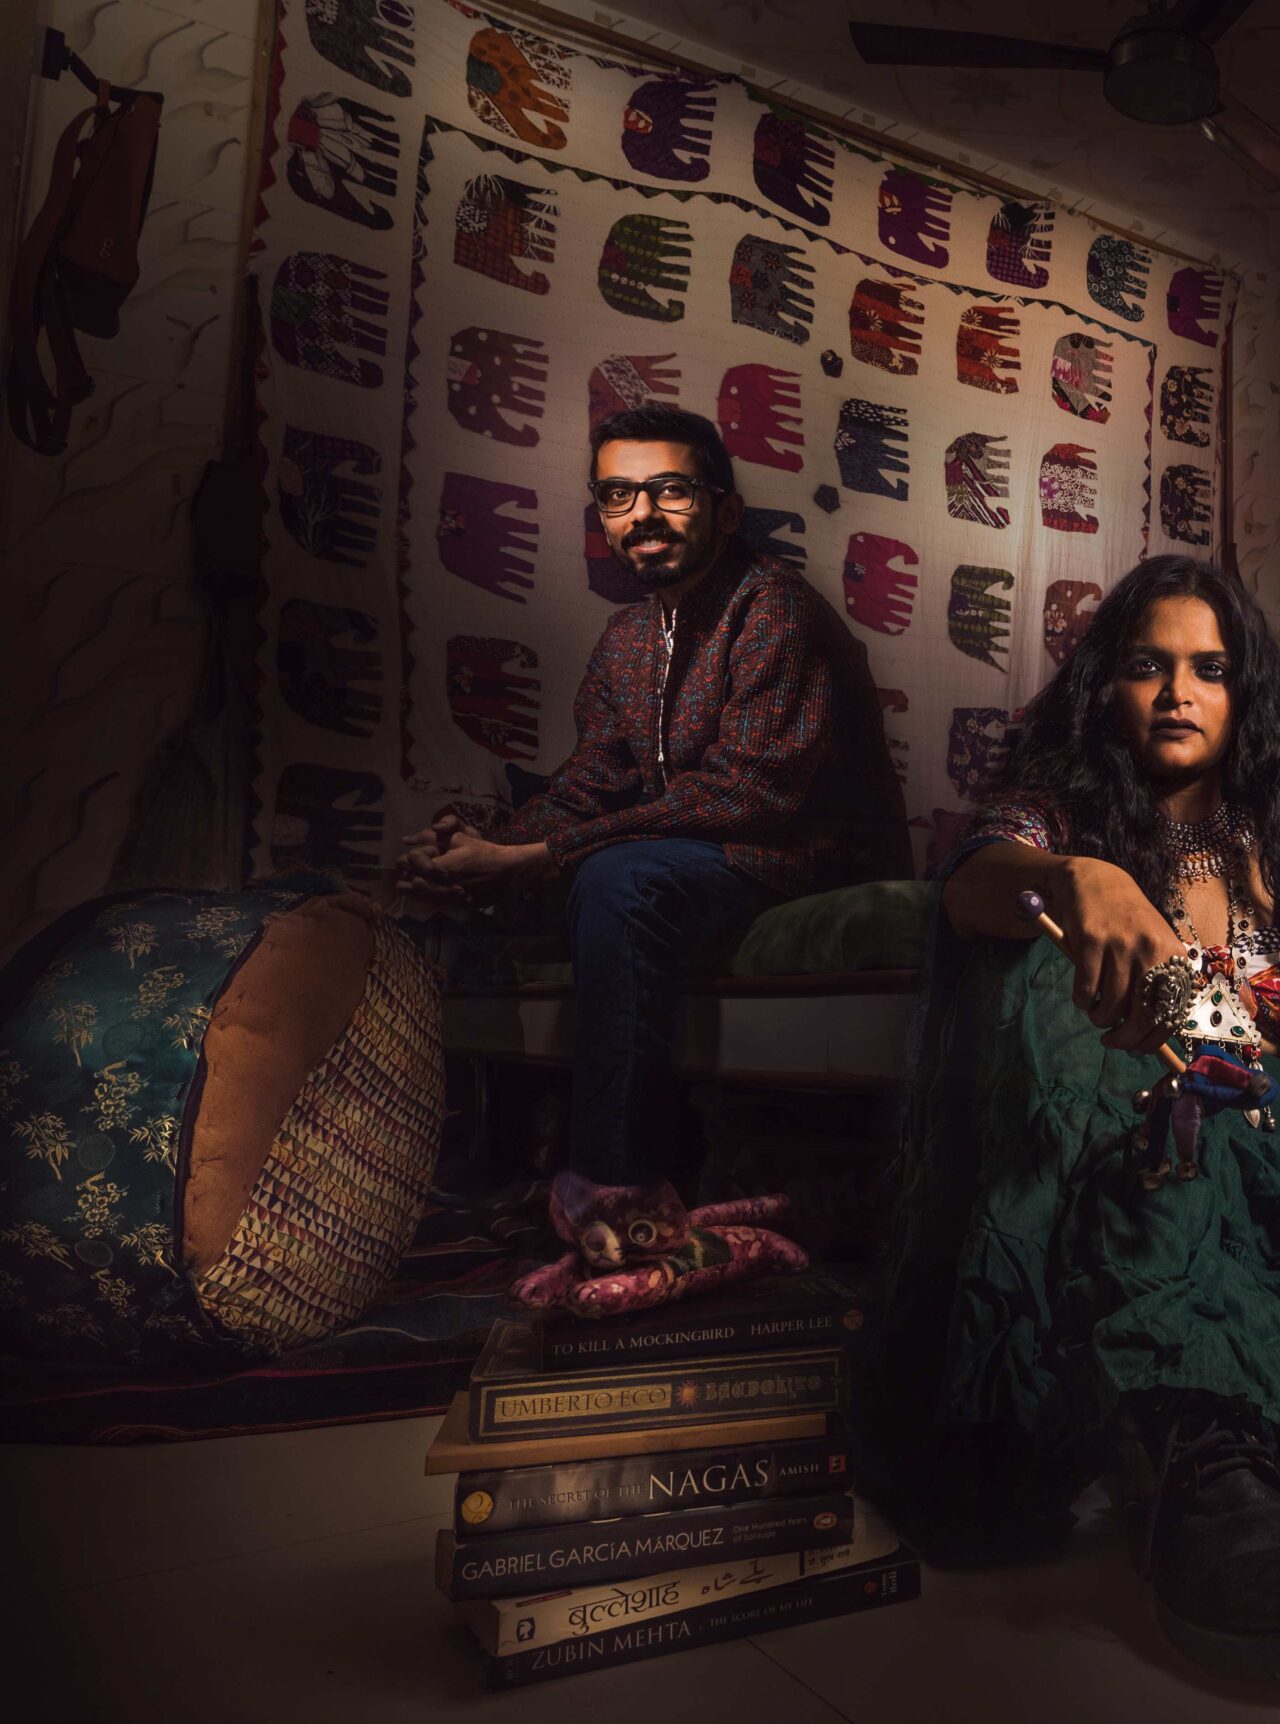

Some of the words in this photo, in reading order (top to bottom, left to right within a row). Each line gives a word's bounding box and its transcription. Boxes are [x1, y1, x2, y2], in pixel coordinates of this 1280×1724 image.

[750, 1318, 806, 1336] HARPER
[809, 1316, 833, 1330] LEE
[552, 1343, 574, 1356] TO
[577, 1340, 611, 1354] KILL
[615, 1338, 625, 1350] A
[629, 1327, 735, 1348] MOCKINGBIRD
[501, 1392, 613, 1417] UMBERTO
[620, 1387, 667, 1407] ECO
[779, 1463, 819, 1477] AMISH
[509, 1496, 534, 1510] THE
[539, 1489, 592, 1505] SECRET
[594, 1487, 611, 1499] OF
[617, 1483, 644, 1497] THE
[649, 1459, 769, 1501] NAGAS
[732, 1533, 742, 1544] of
[743, 1529, 777, 1543] Solitude
[733, 1524, 750, 1534] One
[752, 1518, 786, 1531] Hundred
[788, 1516, 807, 1526] Years
[461, 1553, 547, 1581] GABRIEL
[635, 1527, 724, 1553] MÁRQUEZ
[709, 1615, 728, 1629] THE
[763, 1604, 776, 1616] OF
[779, 1601, 792, 1613] MY
[531, 1637, 605, 1671] ZUBIN
[613, 1621, 692, 1653] MEHTA
